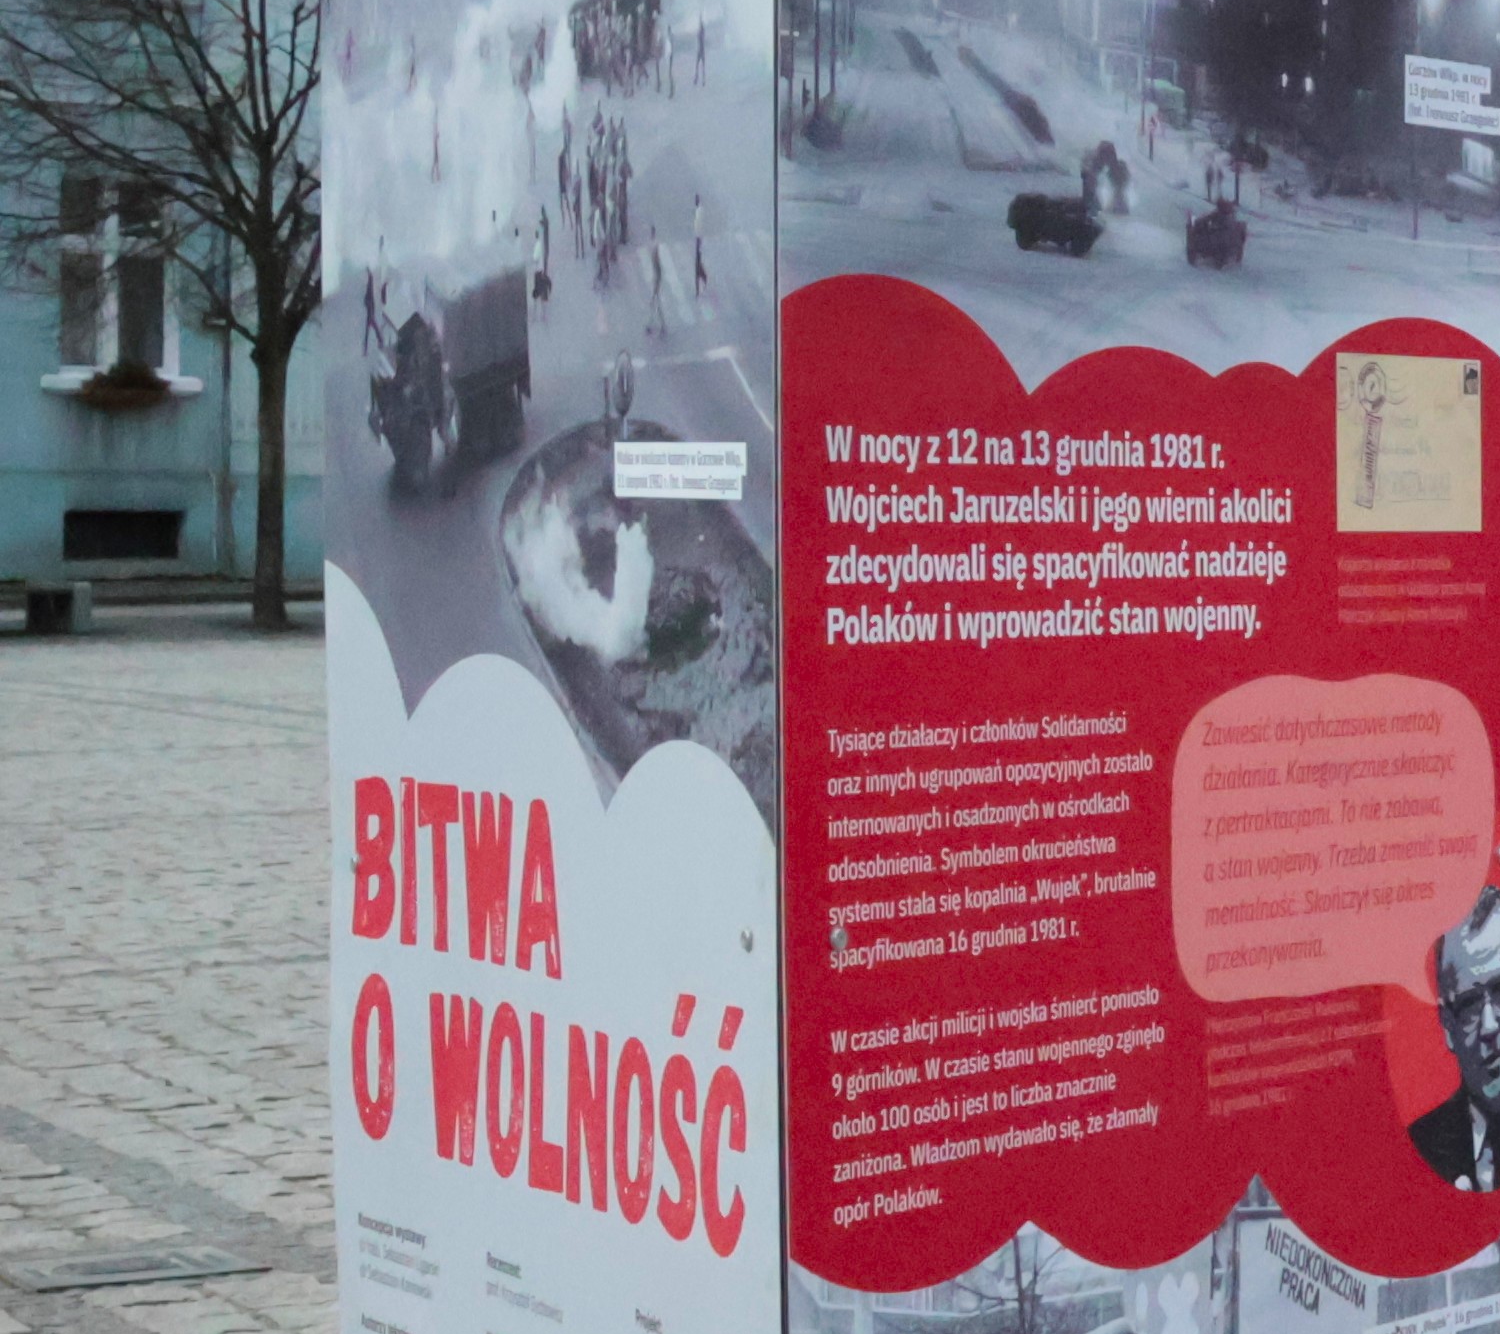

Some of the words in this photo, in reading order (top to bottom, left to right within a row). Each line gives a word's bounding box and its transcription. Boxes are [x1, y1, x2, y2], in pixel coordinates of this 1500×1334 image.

[826, 425, 852, 462] W
[860, 434, 920, 473] nocy
[927, 436, 940, 464] z
[947, 428, 978, 464] 12
[985, 437, 1014, 465] na
[1021, 430, 1050, 465] 13
[1056, 431, 1145, 476] grudnia
[1151, 434, 1205, 468] 1981
[1211, 443, 1224, 468] r.
[826, 484, 943, 532] Wojciech
[950, 486, 1074, 523] Jaruzelski
[1081, 486, 1087, 522] i
[1092, 486, 1141, 532] jego
[1146, 487, 1215, 523] wierni
[1220, 488, 1291, 523] akolici
[826, 543, 985, 592] zdecydowali
[992, 543, 1027, 590] się
[1033, 541, 1189, 589] spacyfikować
[1195, 541, 1286, 584] nadzieje
[828, 604, 938, 644] Polaków
[945, 603, 951, 640] i
[958, 600, 1104, 649] wprowadzić
[1109, 602, 1158, 635] stan
[1164, 597, 1261, 640] wojenny.
[352, 776, 561, 978] BITWA
[352, 974, 395, 1140] O
[429, 993, 747, 1257] WOLNOŚĆ
